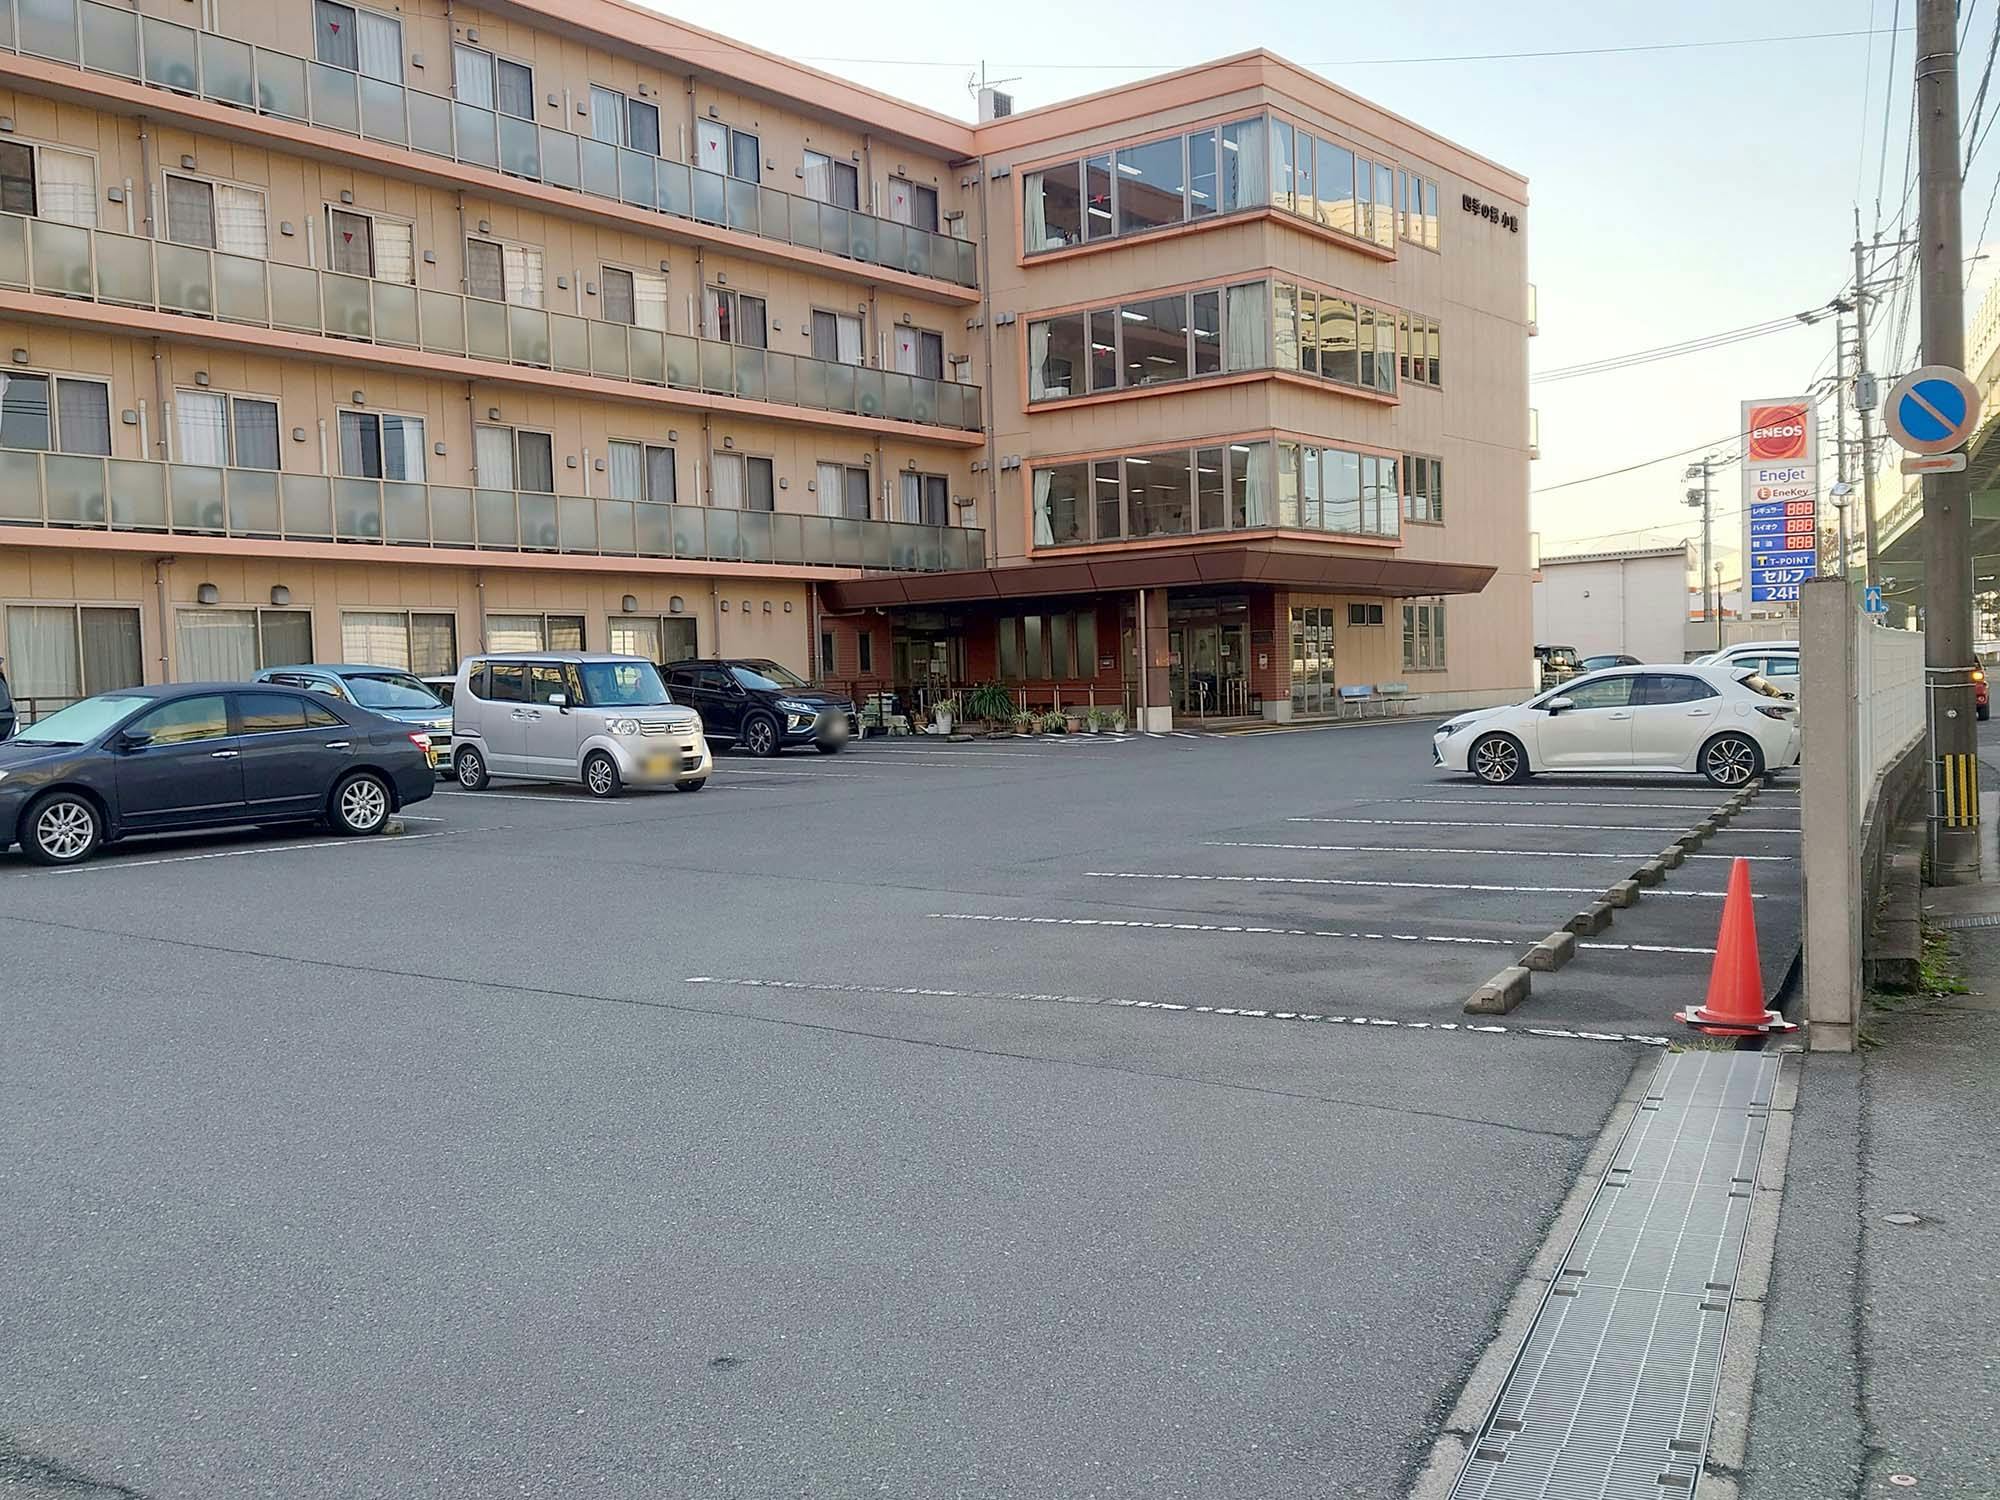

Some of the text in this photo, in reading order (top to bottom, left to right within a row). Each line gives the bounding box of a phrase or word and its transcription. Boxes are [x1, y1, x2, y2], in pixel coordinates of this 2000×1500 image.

[1753, 425, 1802, 439] ENEOS
[1760, 468, 1806, 483] EneJet
[1773, 488, 1809, 497] EneKey
[1753, 506, 1784, 515] レギュラー
[1753, 523, 1778, 531] ハイオク
[1769, 556, 1810, 565] T-POINT
[1762, 570, 1805, 583] セルフ
[1766, 587, 1800, 600] 24H
